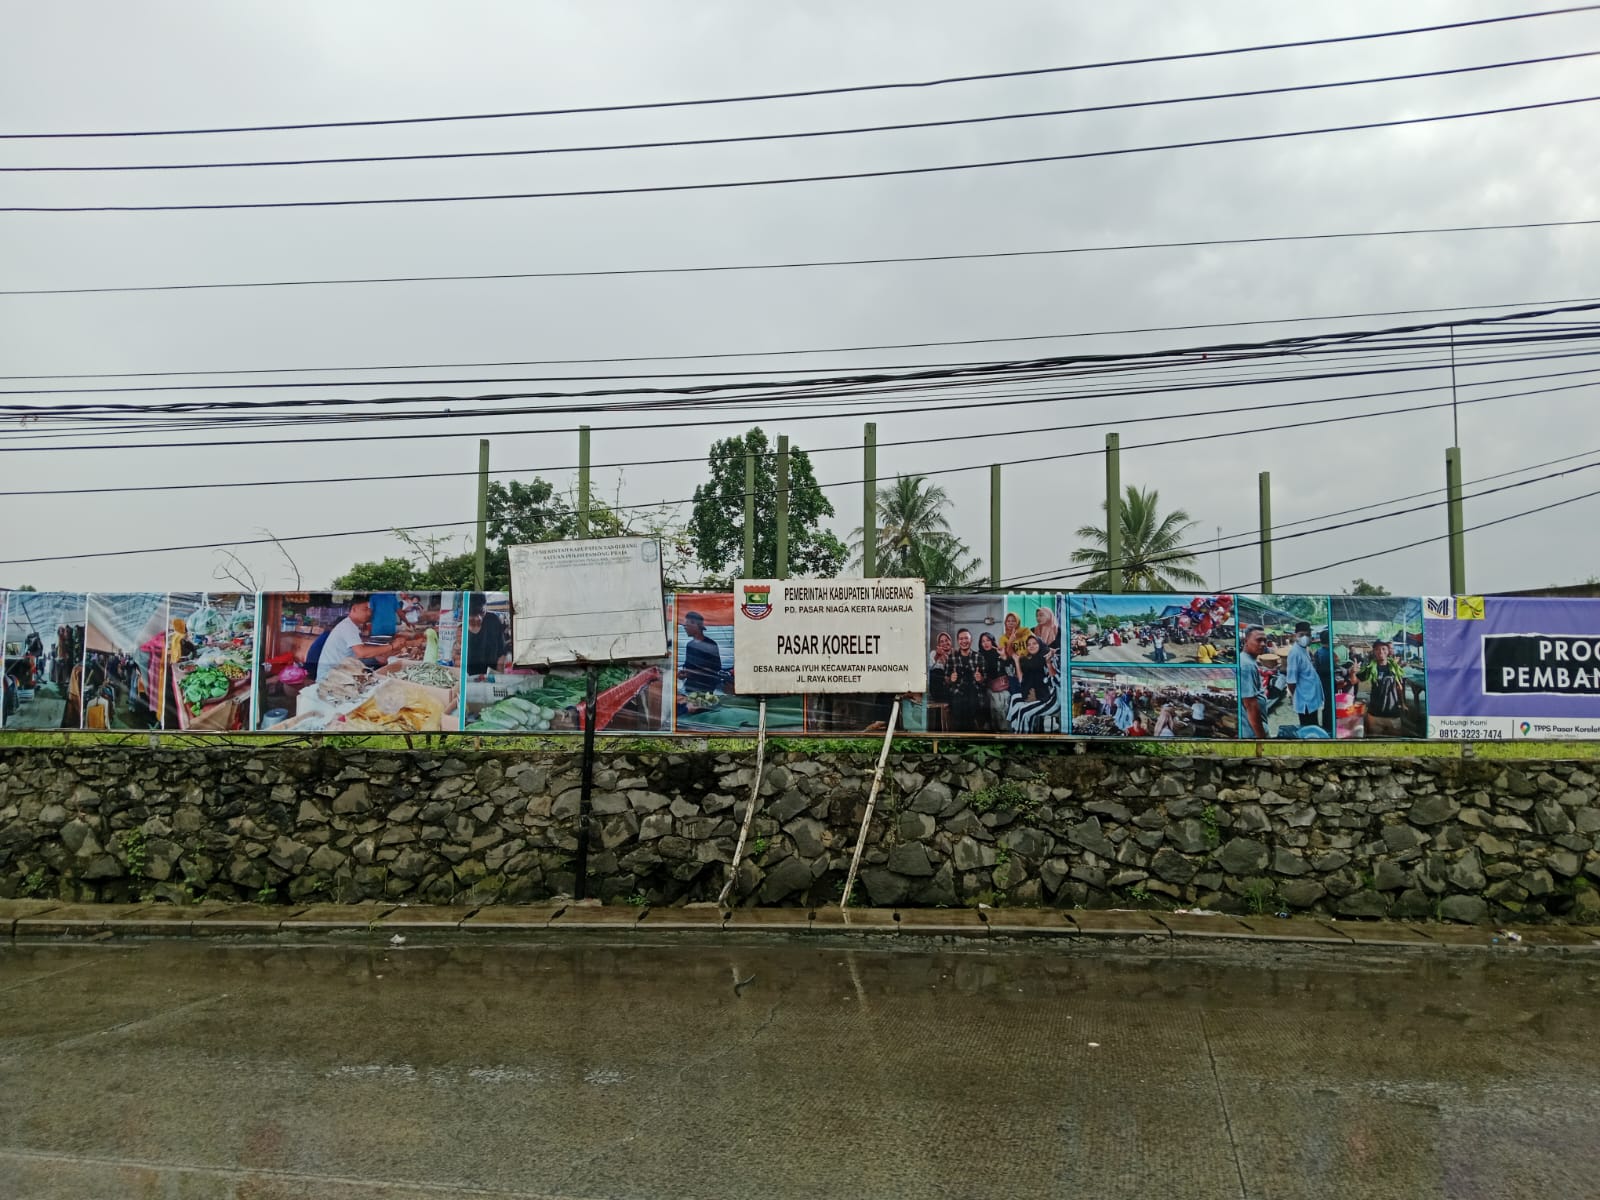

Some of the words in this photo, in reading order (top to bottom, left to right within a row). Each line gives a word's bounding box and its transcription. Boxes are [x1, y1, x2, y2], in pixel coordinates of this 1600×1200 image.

[784, 587, 828, 601] PEMERINTAH
[829, 587, 870, 600] KABUPATEN
[871, 586, 914, 600] TANGERANG
[784, 606, 798, 614] PD.
[799, 606, 824, 614] PASAR
[777, 635, 819, 655] PASAR
[822, 635, 881, 655] KORELET
[753, 665, 773, 673] DESA
[774, 665, 801, 673] RANCA
[802, 665, 819, 673] IYUH
[867, 664, 909, 672] PANONGAN
[807, 675, 826, 683] RAYA
[827, 675, 862, 683] KORELET
[1440, 719, 1469, 728] Hubungi
[1470, 719, 1487, 727] Kami
[1534, 725, 1552, 733] TPPS
[1552, 725, 1573, 733] Pasar
[1439, 729, 1502, 739] 0812-3223-7474
